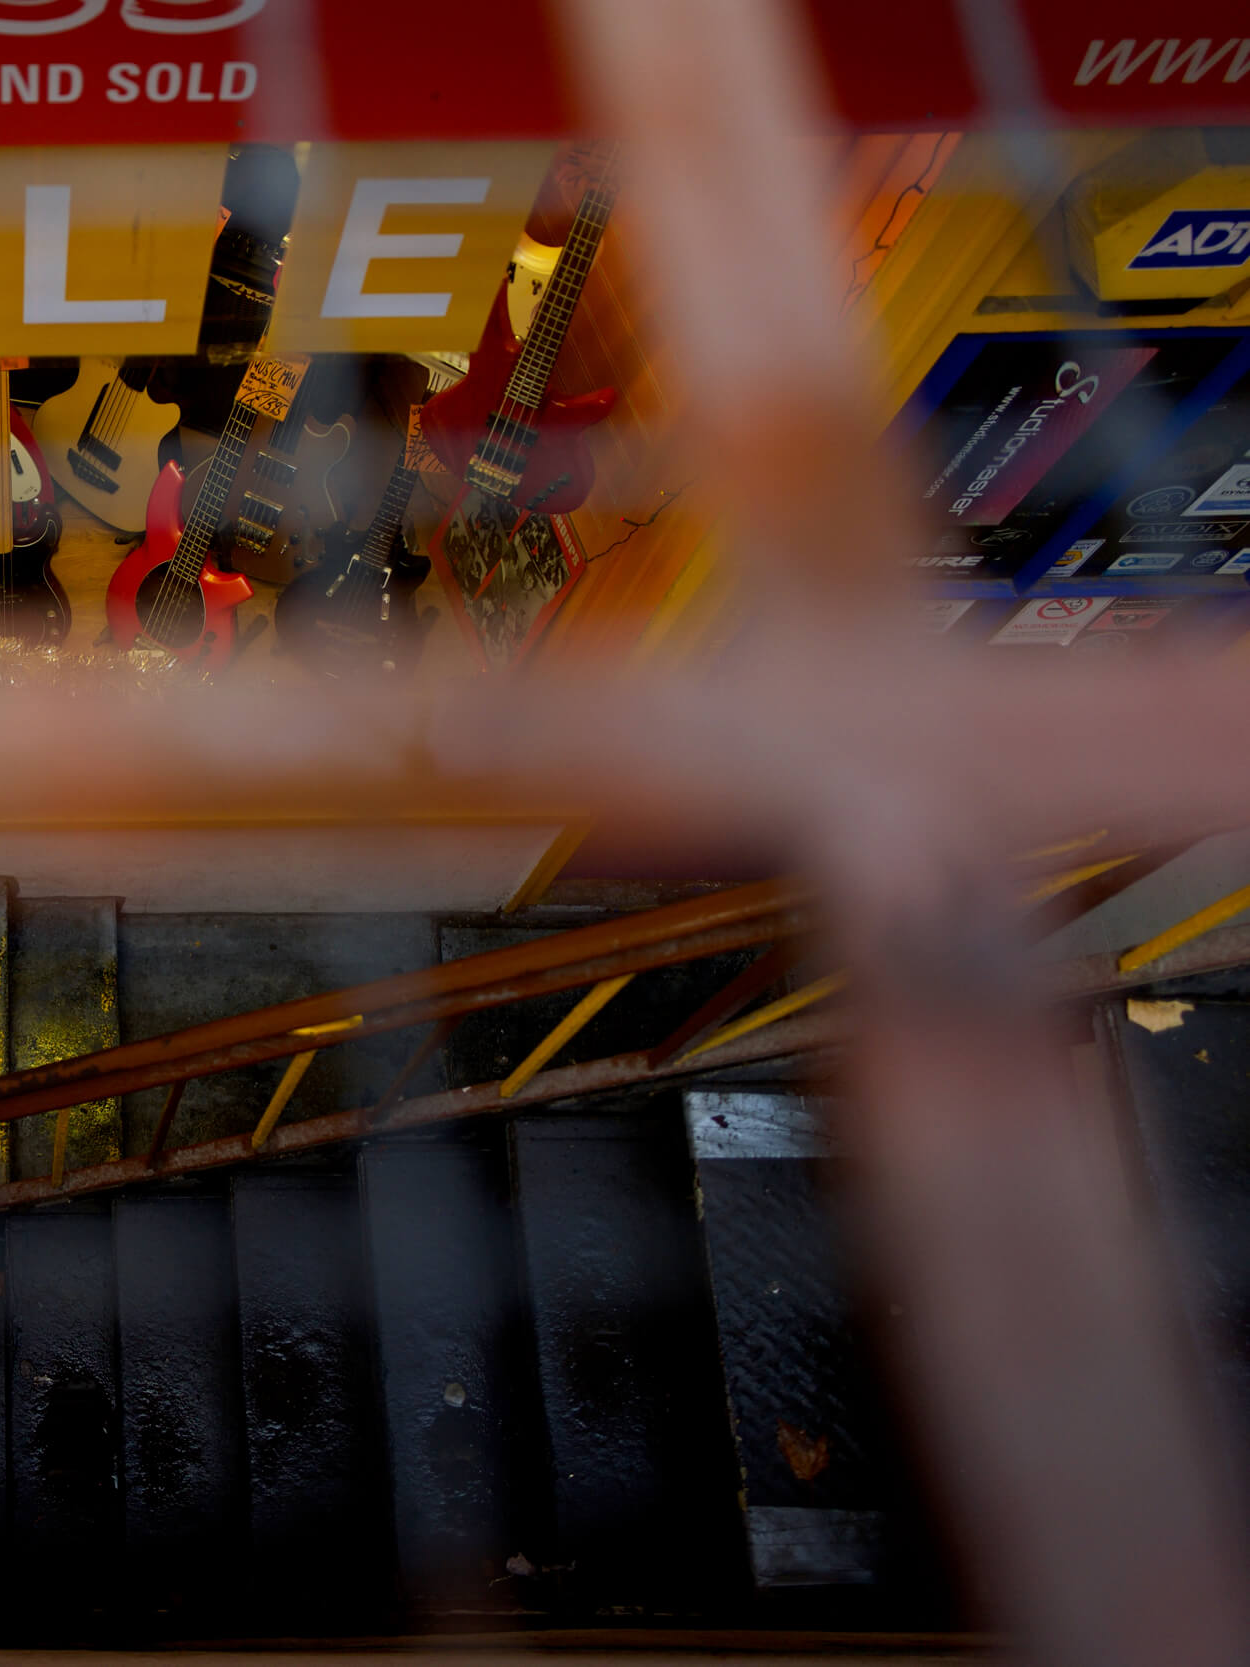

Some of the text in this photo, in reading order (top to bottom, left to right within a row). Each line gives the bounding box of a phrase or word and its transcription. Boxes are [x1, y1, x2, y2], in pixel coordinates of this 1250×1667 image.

[105, 61, 258, 103] SOLD
[1141, 220, 1250, 257] ADT
[948, 360, 1099, 517] Studiomaster
